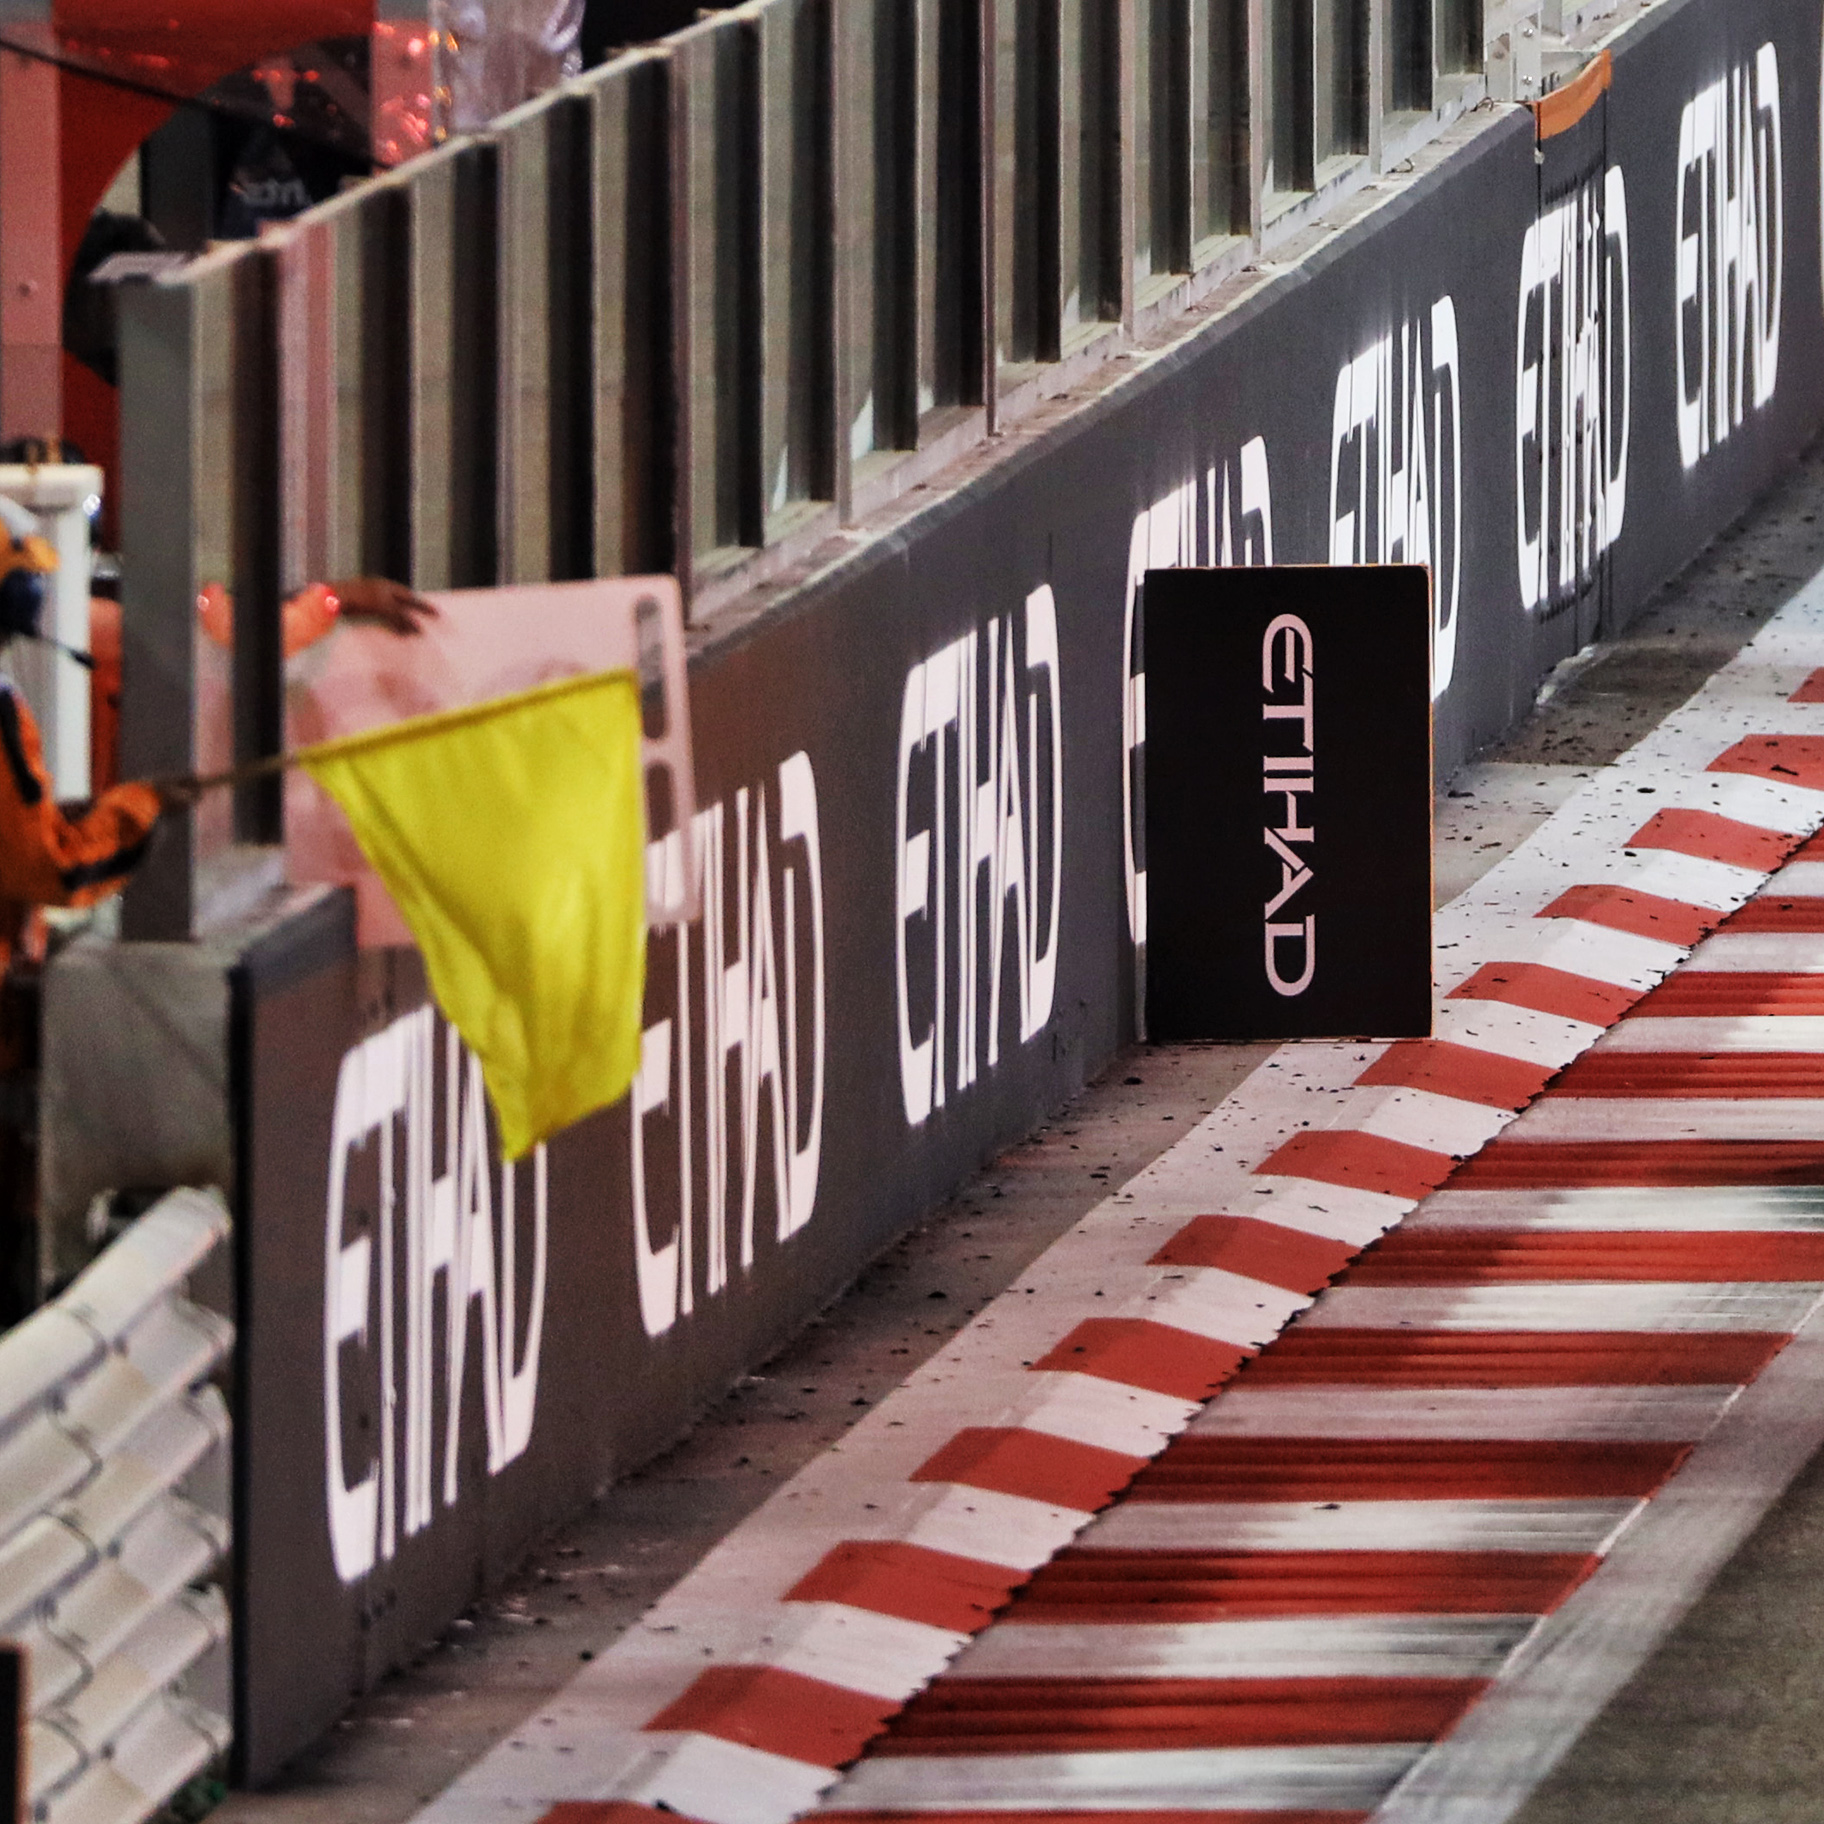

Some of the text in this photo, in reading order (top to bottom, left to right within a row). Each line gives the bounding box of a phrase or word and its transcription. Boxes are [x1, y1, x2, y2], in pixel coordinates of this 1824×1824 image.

[1517, 164, 1630, 611] ETIHAD
[1676, 40, 1782, 472] ETIHAD
[896, 582, 1064, 1129] ETIHAD
[1260, 613, 1316, 997] ETIHAD
